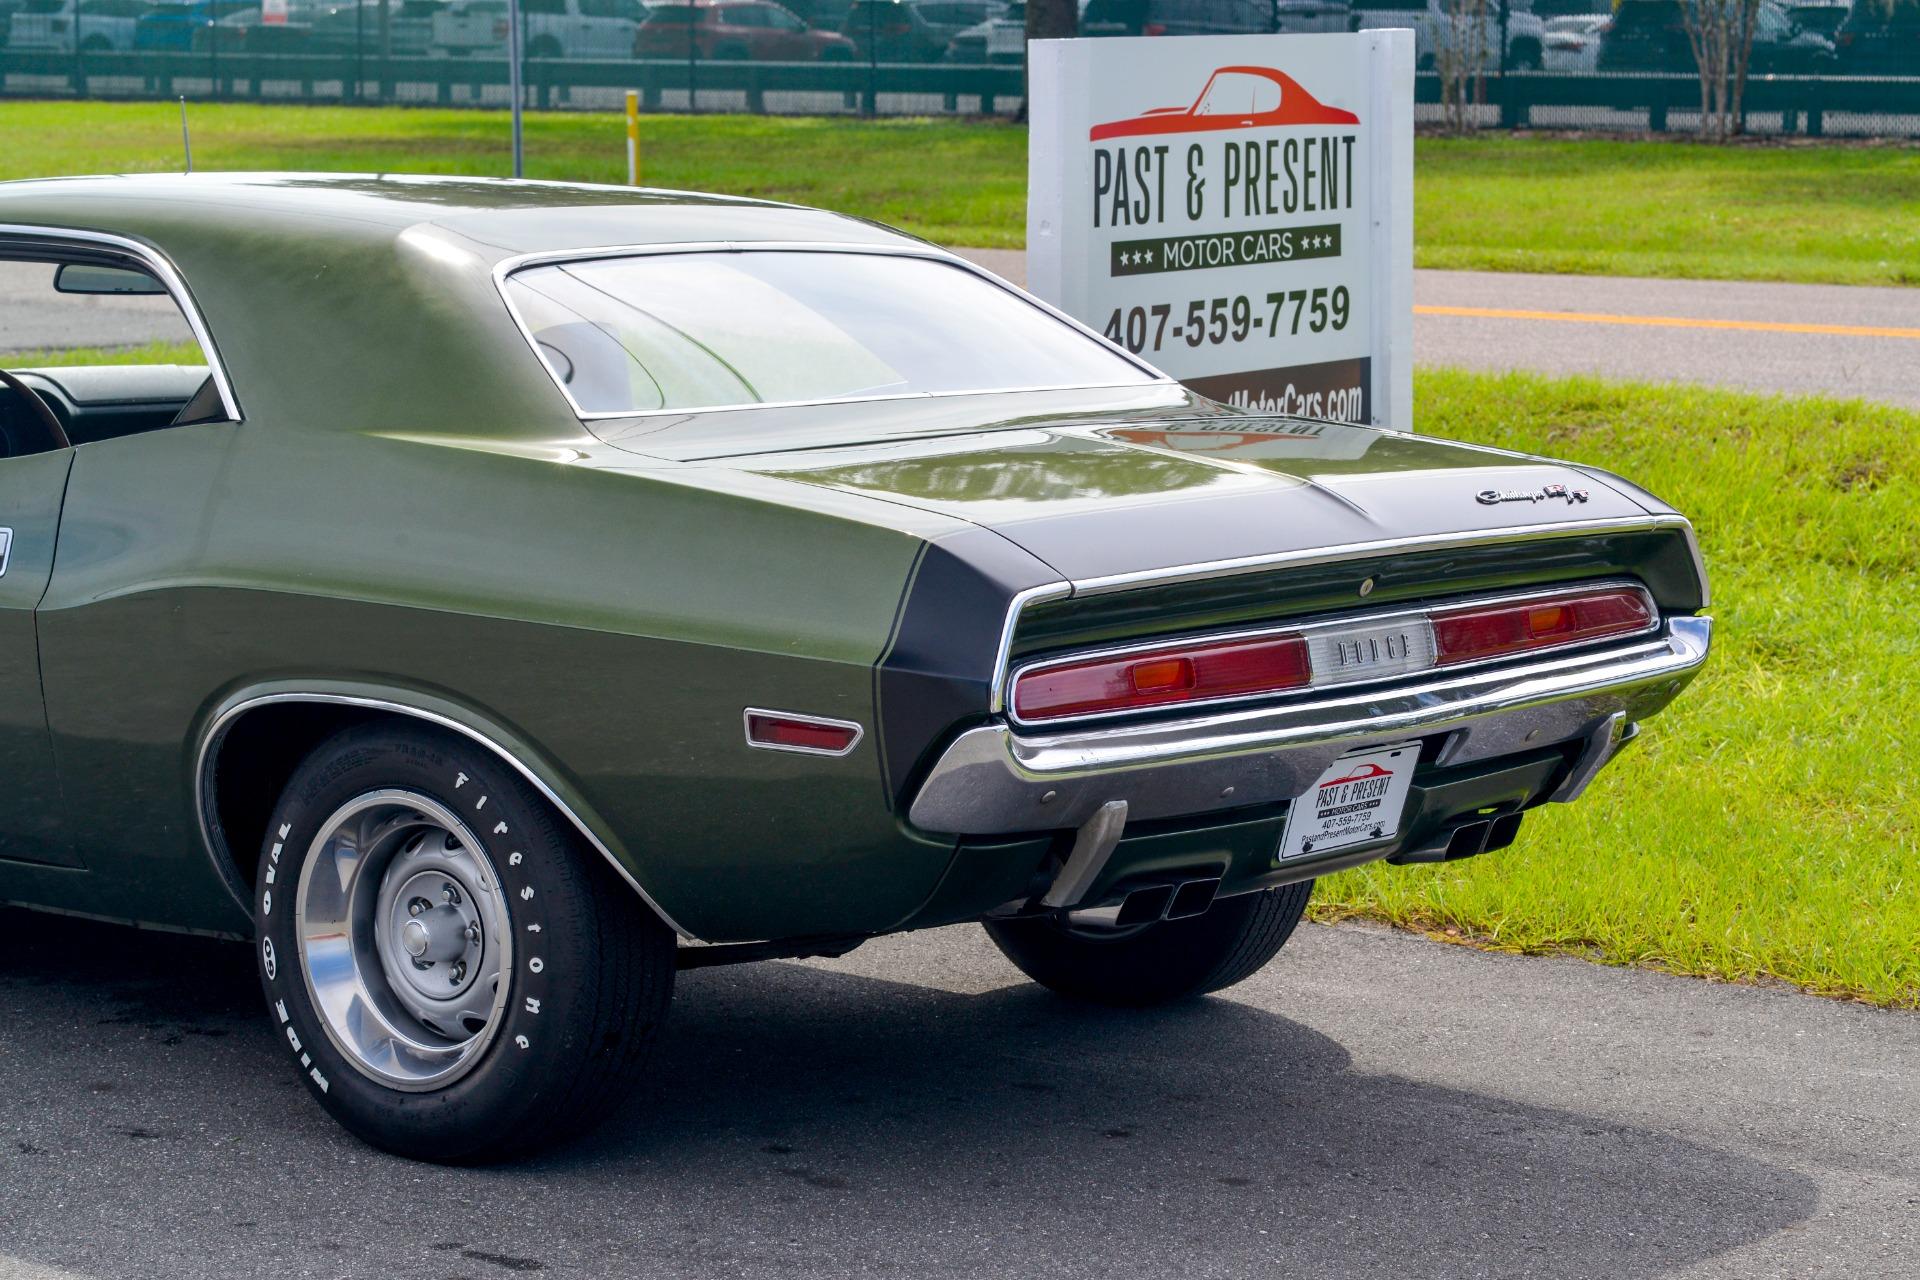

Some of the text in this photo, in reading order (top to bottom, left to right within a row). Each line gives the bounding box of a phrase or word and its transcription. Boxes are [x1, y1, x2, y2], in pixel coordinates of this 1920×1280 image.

[1094, 135, 1356, 228] PAST & PRESENT
[1163, 232, 1293, 268] MOTOR CARS
[1103, 285, 1350, 354] 407-559-7759
[1338, 633, 1411, 665] DODGE
[1316, 777, 1391, 808] PAST & PRESENT
[1322, 811, 1372, 829] 407-559-7759
[263, 822, 292, 916] OVAL
[275, 999, 329, 1094] WIDE
